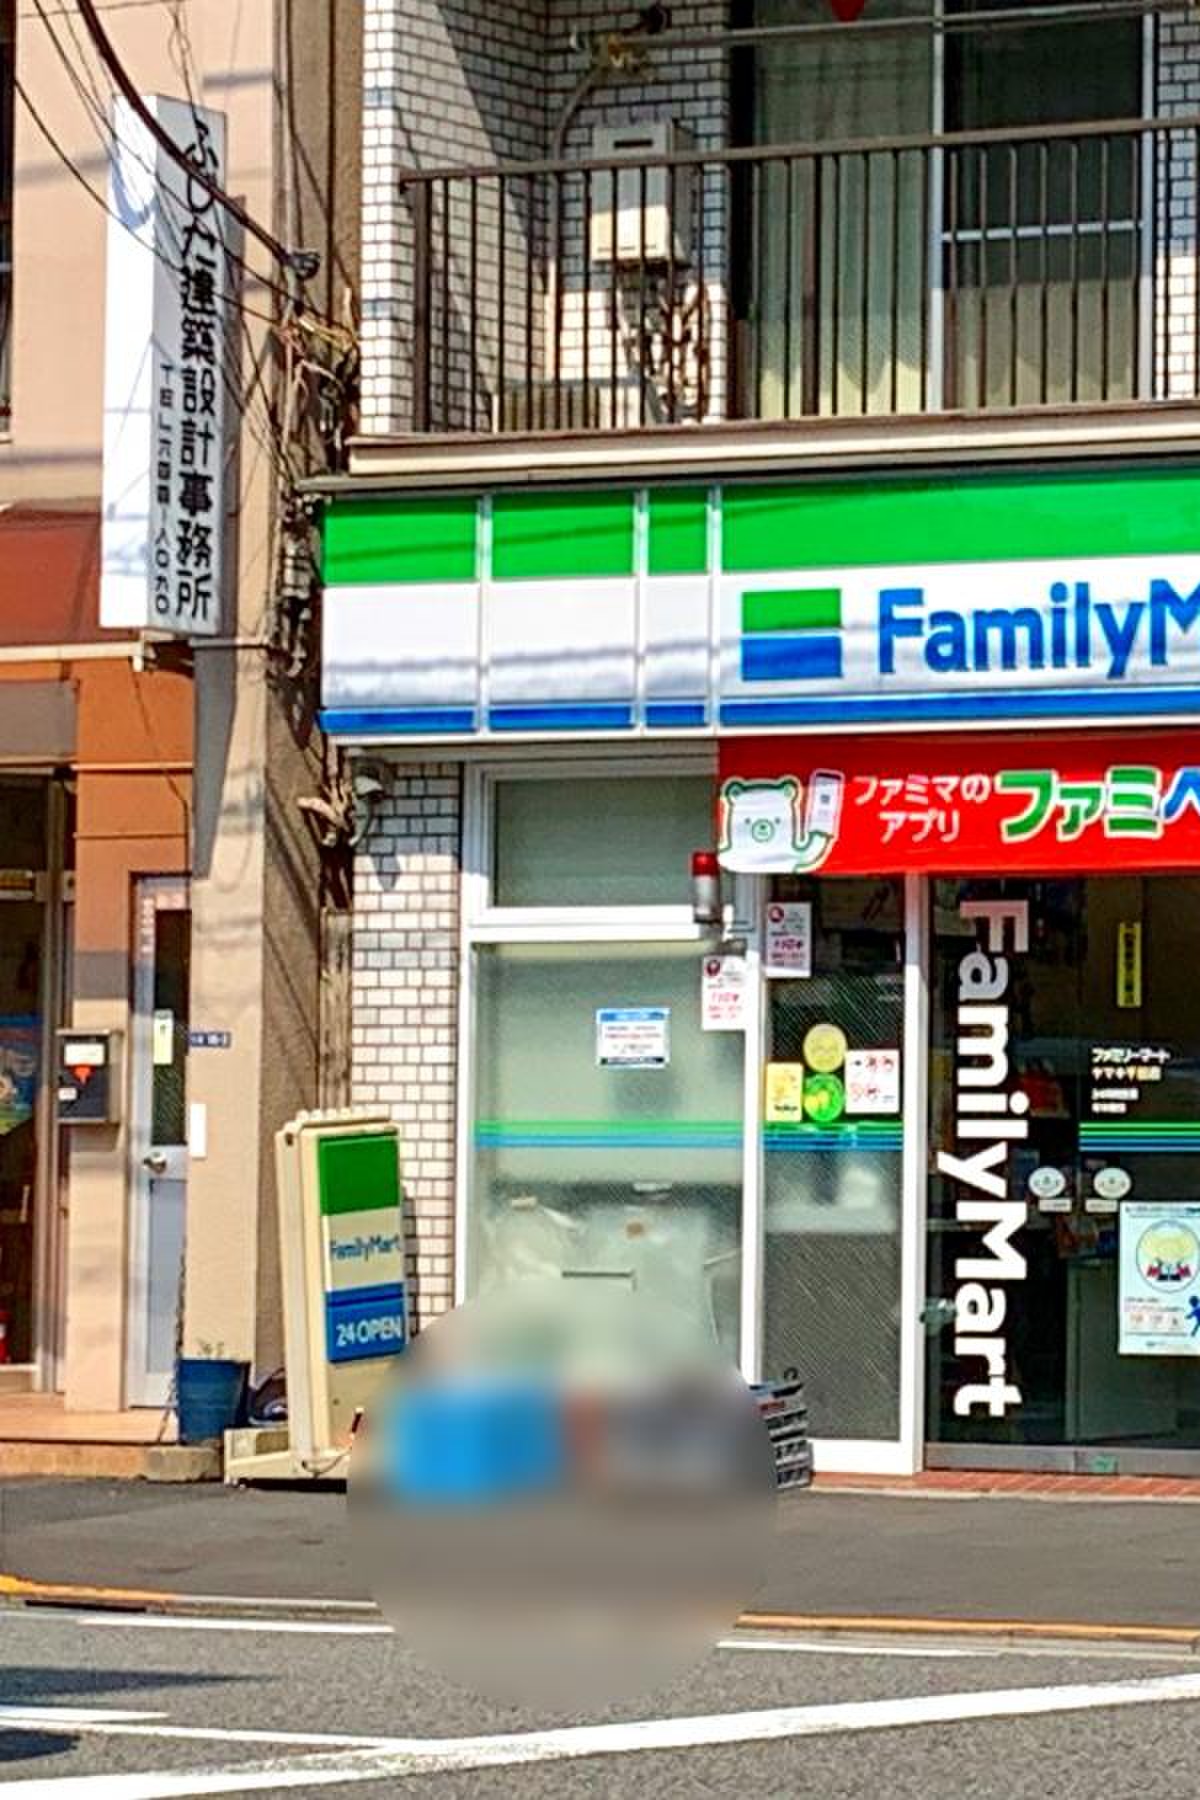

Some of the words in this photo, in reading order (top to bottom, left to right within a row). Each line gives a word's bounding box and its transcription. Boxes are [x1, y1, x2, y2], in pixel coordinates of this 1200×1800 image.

[853, 773, 990, 806] ファミマの
[878, 809, 960, 843] アプリ
[937, 899, 1030, 1417] FamilyMart
[331, 1233, 401, 1261] FamilyMart
